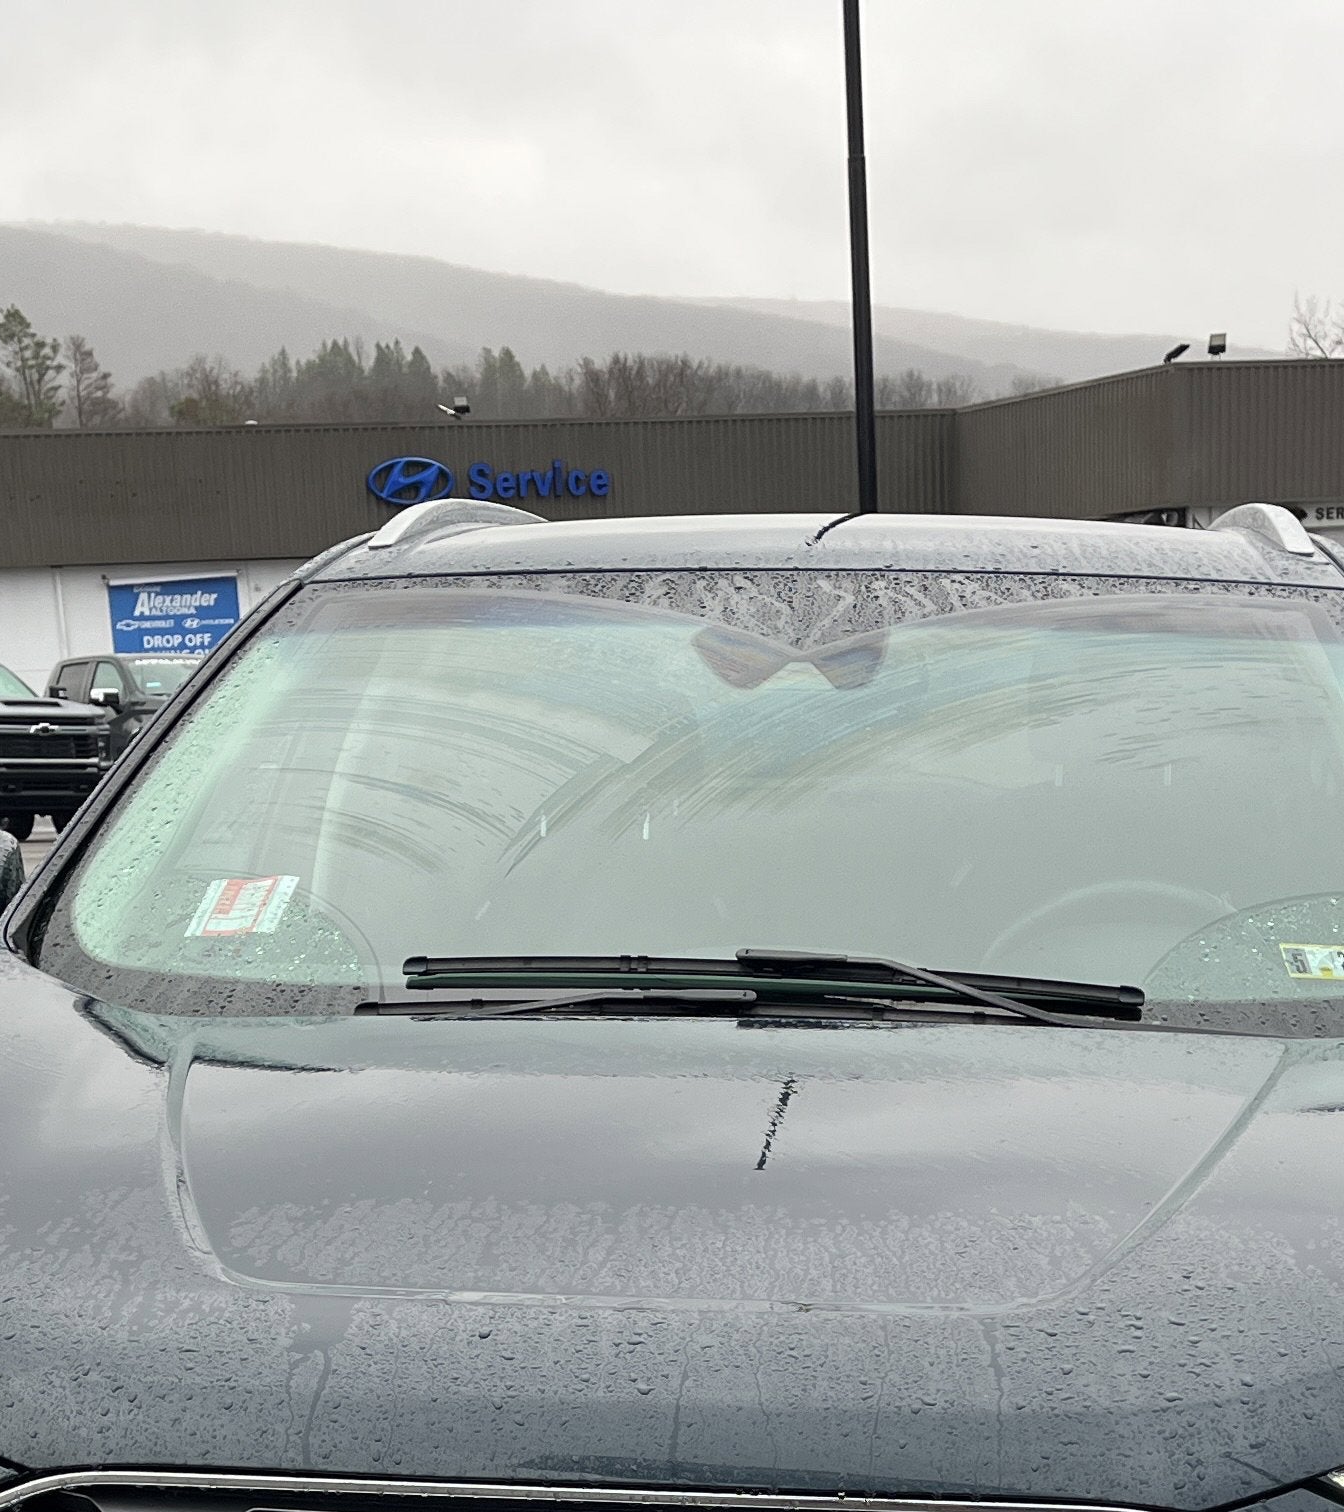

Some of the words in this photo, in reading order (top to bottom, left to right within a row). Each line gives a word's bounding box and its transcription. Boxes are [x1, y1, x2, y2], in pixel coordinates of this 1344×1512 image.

[467, 458, 611, 500] Service
[133, 590, 218, 616] Alexander
[143, 634, 183, 648] DROP
[185, 633, 212, 647] OFF
